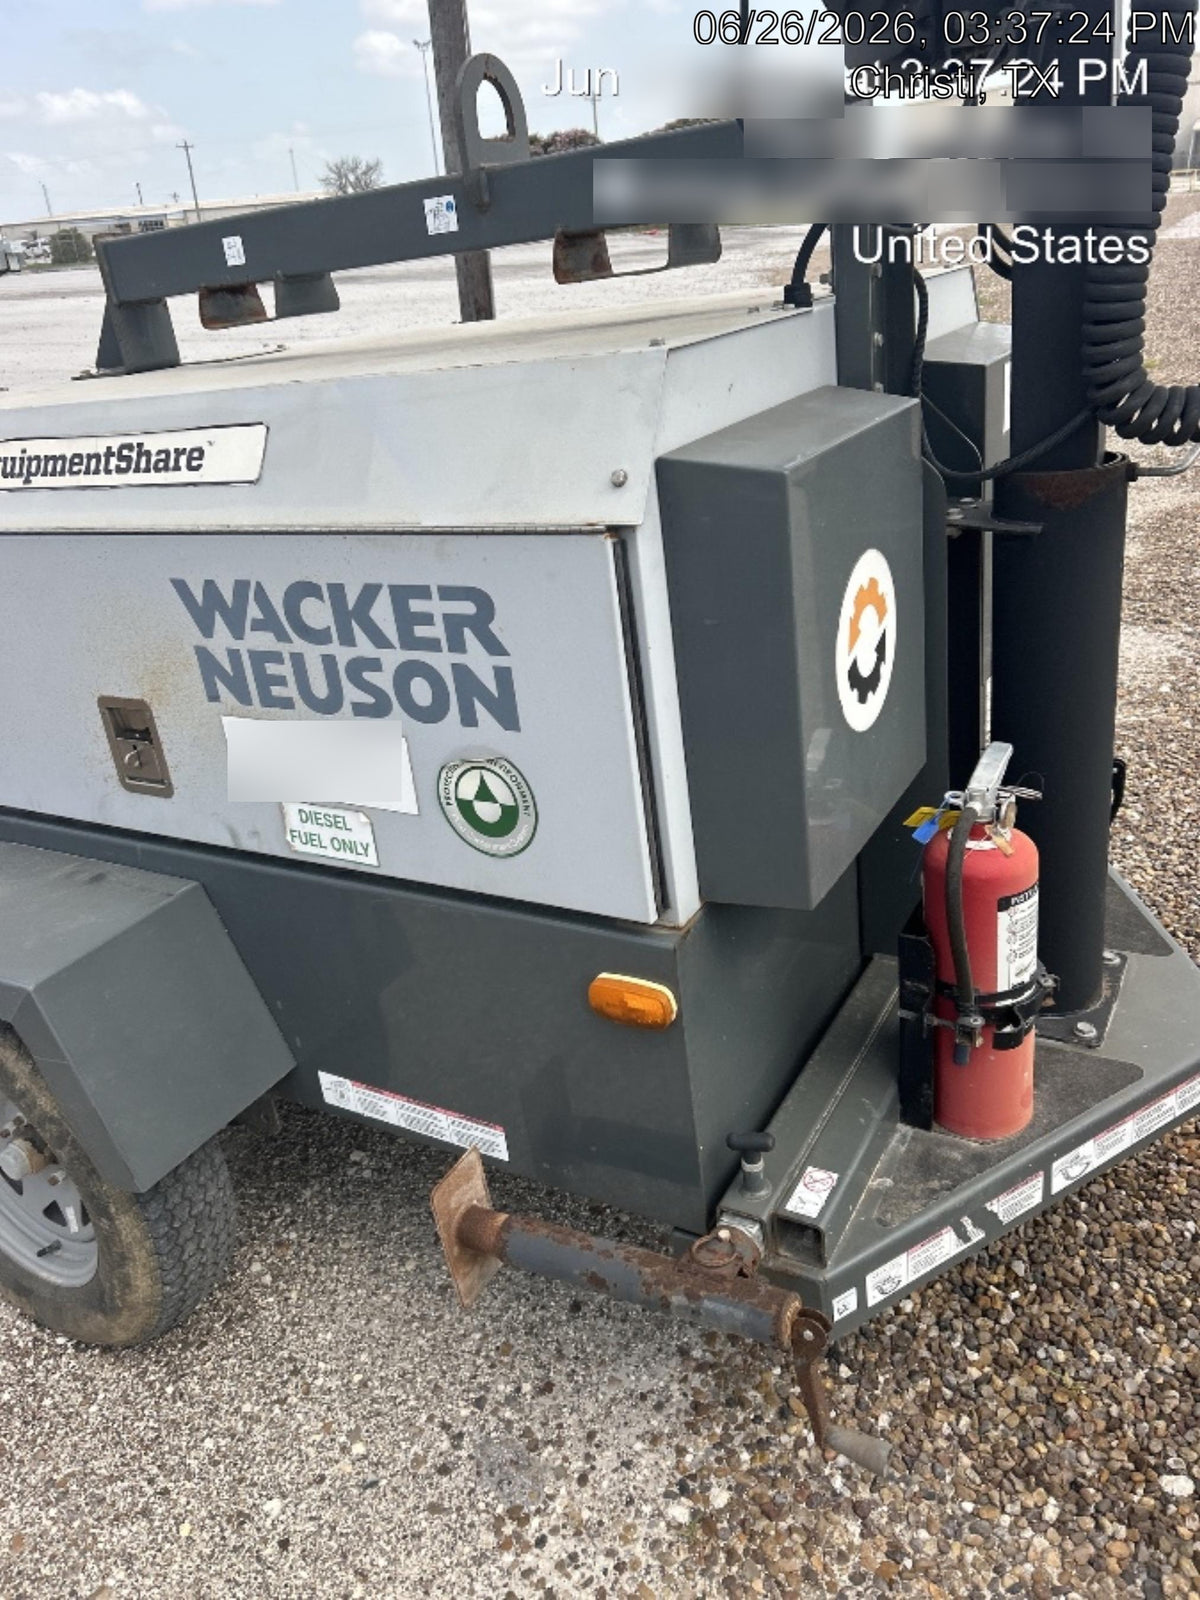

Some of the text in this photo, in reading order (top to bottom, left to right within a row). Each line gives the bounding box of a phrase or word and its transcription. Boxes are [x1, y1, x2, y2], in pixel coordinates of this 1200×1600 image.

[0, 442, 205, 485] uipmentShare
[169, 577, 511, 656] WACKER
[193, 645, 521, 732] NEUSON
[298, 808, 352, 832] DIESEL
[289, 828, 370, 858] FUEL ONLY
